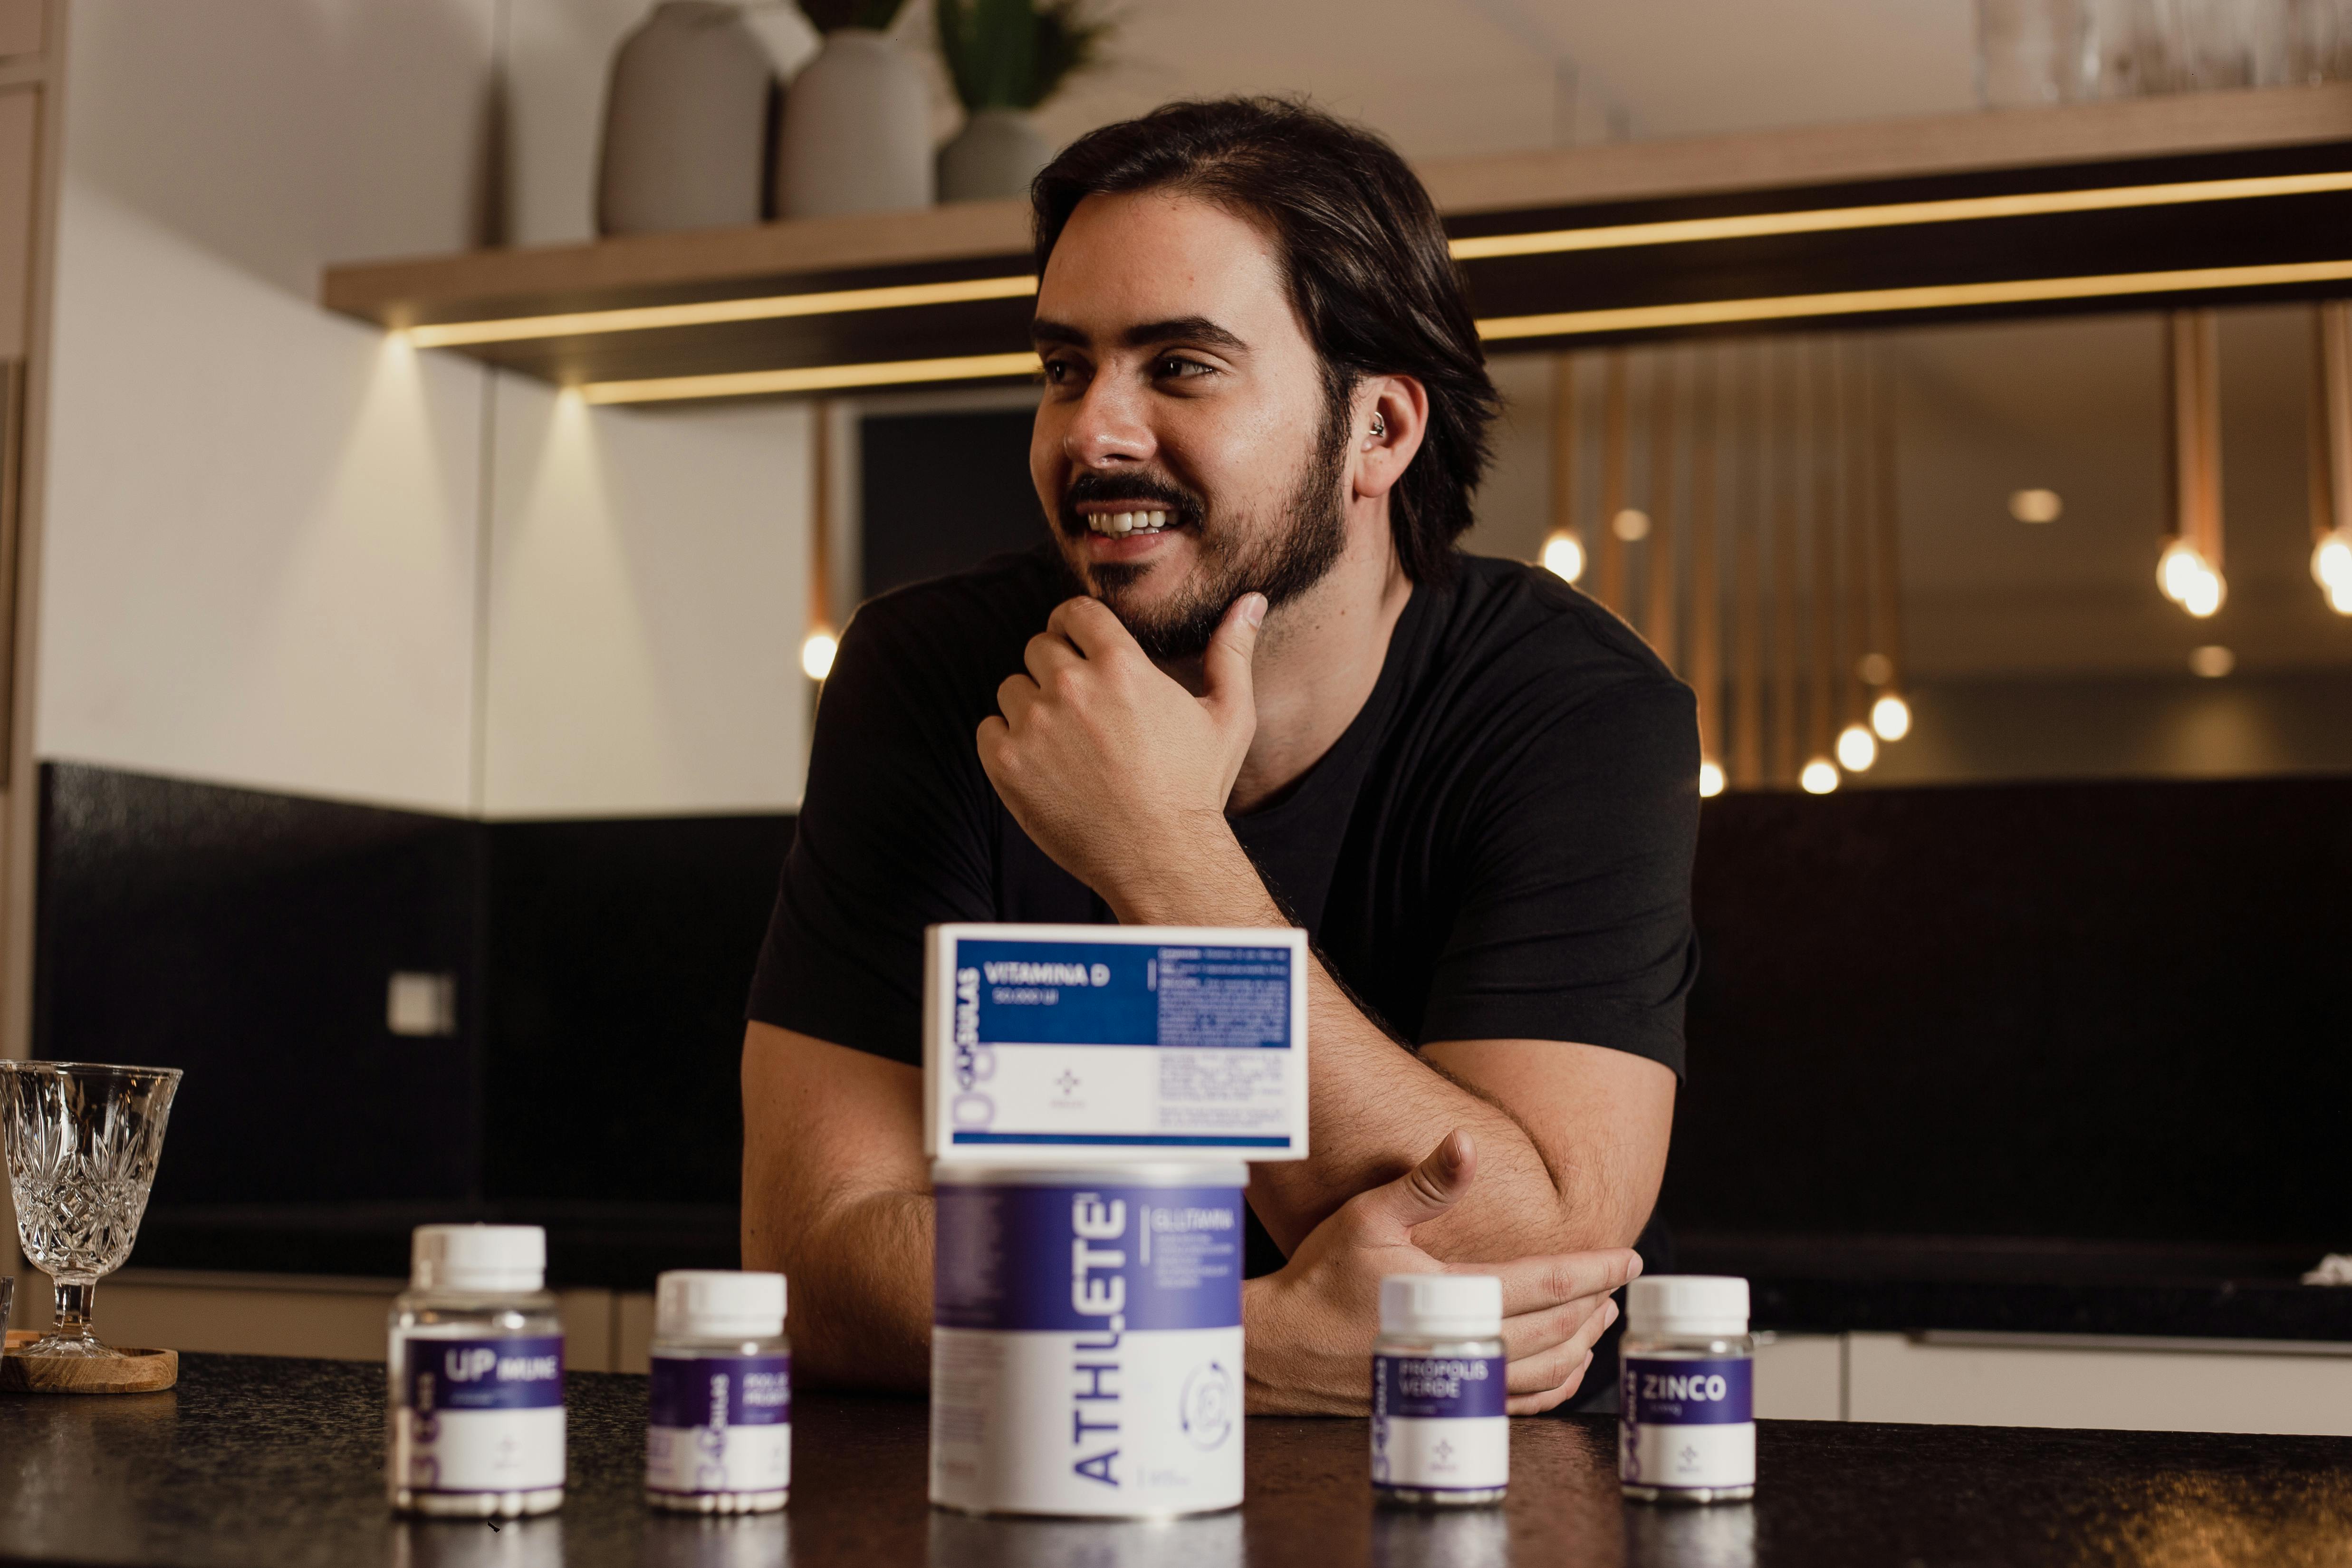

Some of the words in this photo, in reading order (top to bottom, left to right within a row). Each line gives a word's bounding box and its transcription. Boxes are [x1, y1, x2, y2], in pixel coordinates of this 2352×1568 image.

[984, 961, 1089, 986] VITAMINA
[1091, 963, 1110, 987] D
[1072, 1199, 1126, 1487] ATHLETE
[445, 1348, 495, 1381] UP
[1643, 1375, 1726, 1401] ZINCO
